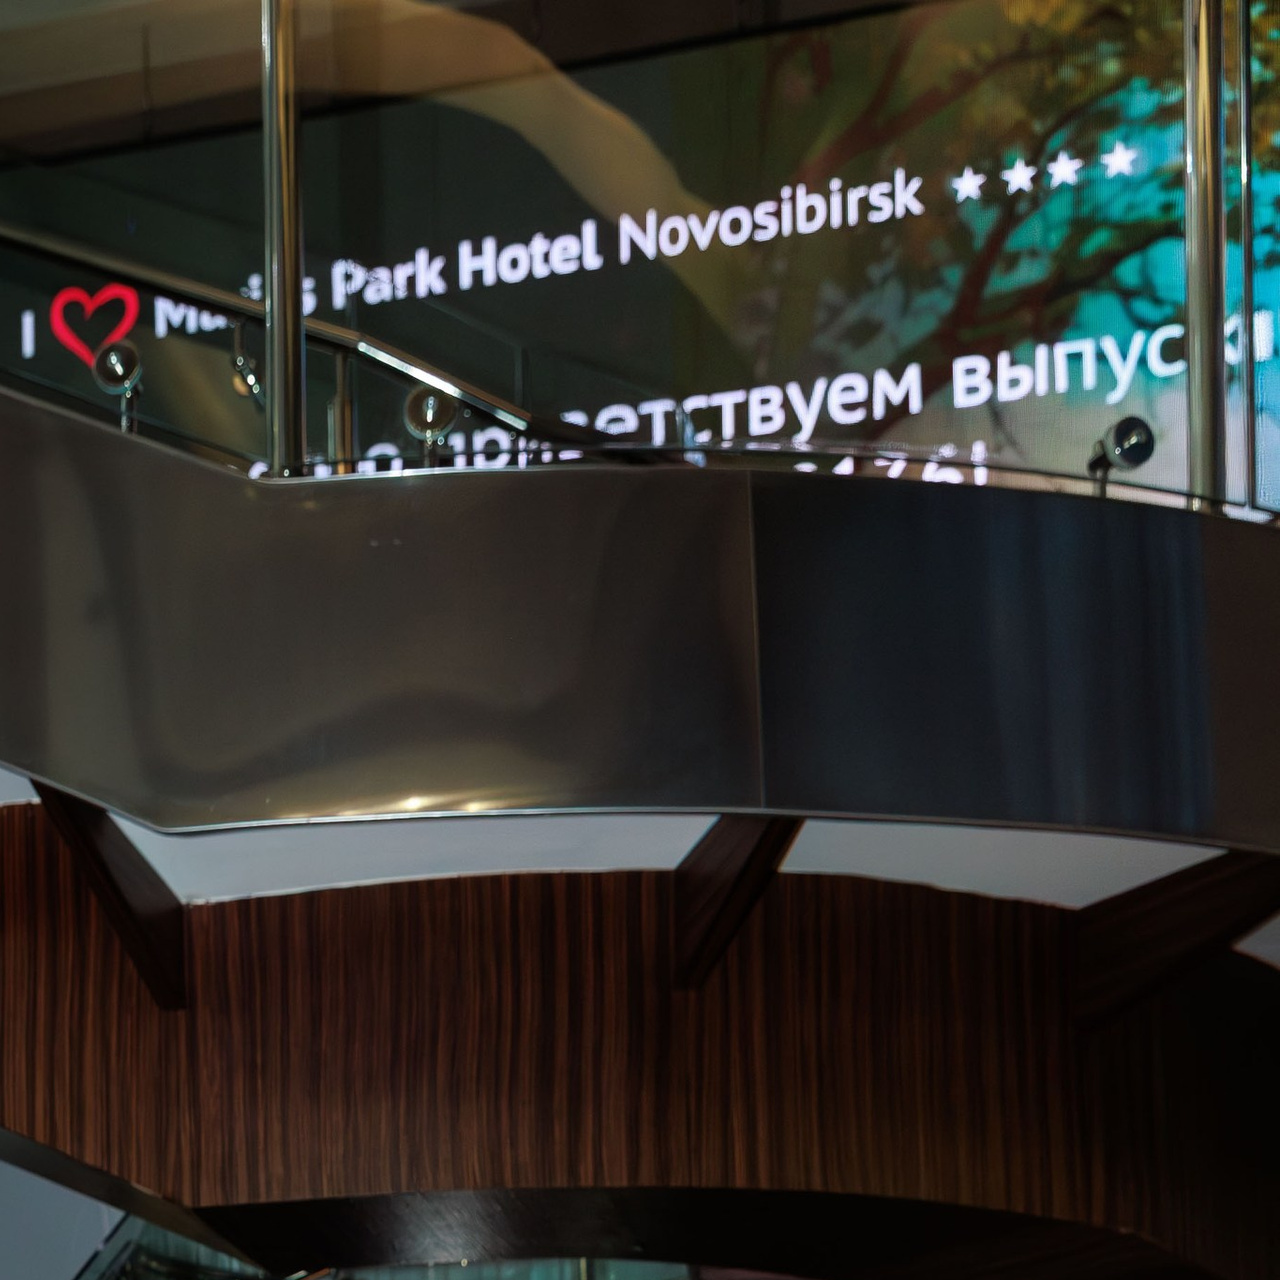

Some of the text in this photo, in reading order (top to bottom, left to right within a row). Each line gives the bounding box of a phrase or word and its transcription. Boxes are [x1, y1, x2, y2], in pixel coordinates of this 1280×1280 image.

[330, 247, 447, 311] Park
[458, 218, 605, 291] Hotel
[618, 166, 926, 266] Novosibirsk
